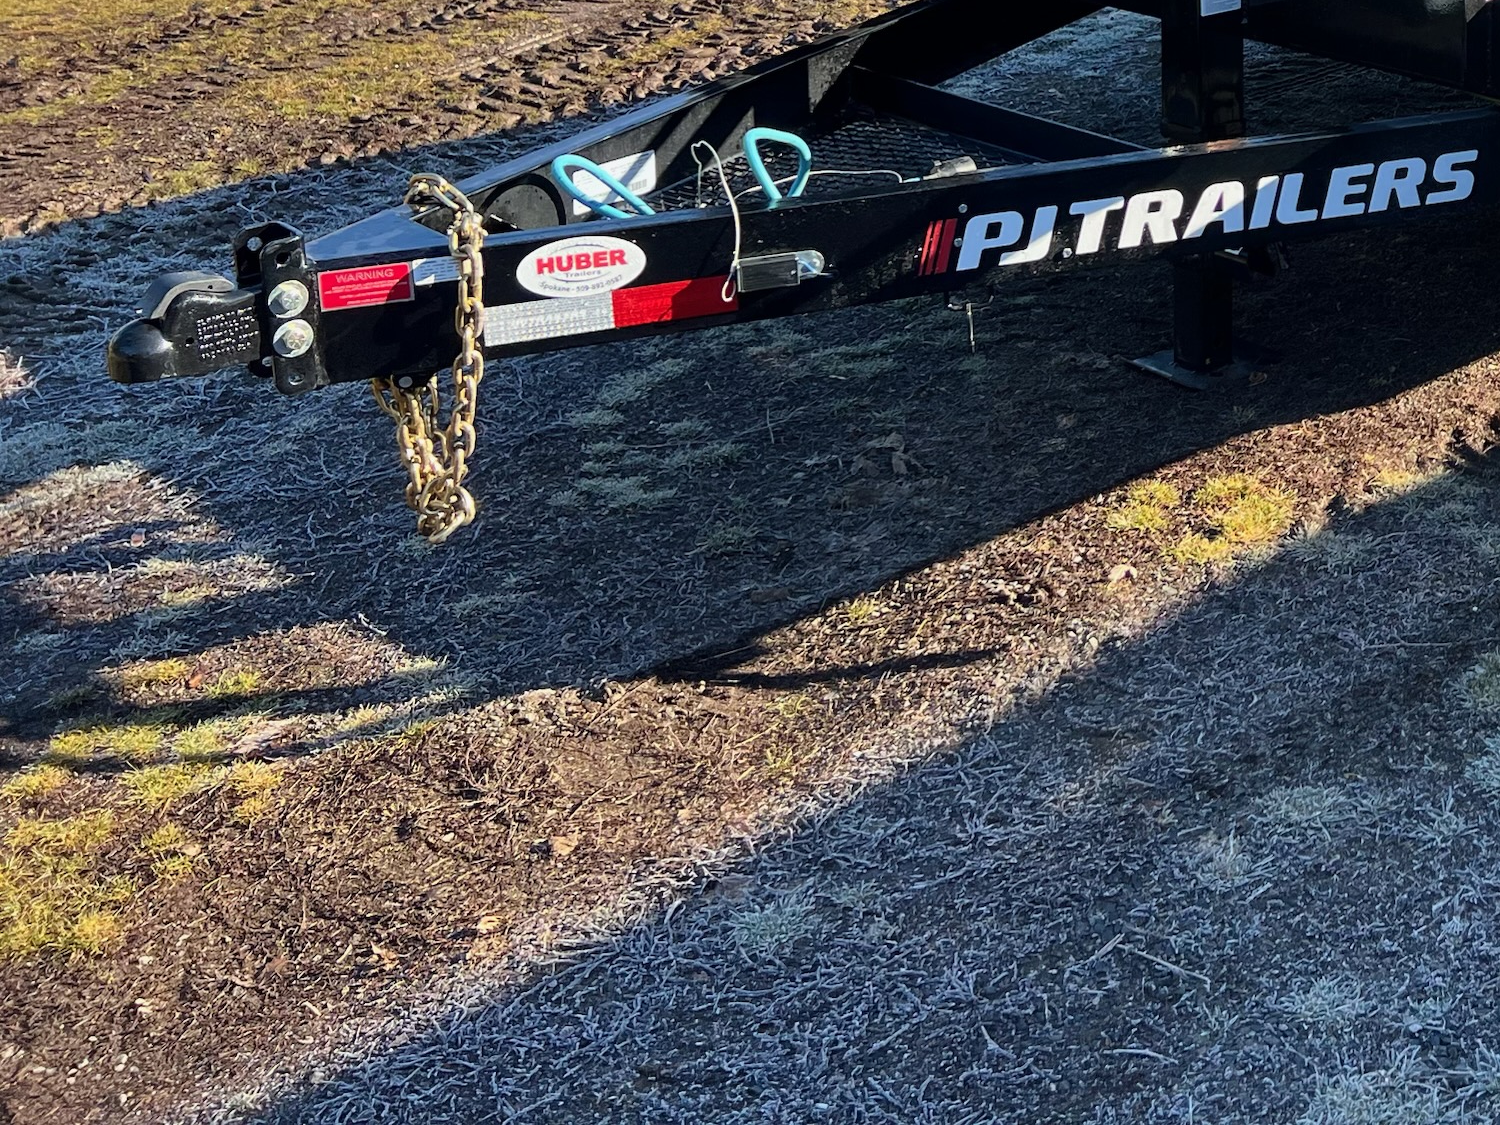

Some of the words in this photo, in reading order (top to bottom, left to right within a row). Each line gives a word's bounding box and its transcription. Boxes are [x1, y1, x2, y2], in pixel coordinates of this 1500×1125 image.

[955, 205, 1058, 271] PJ
[1069, 149, 1479, 256] TRAILERS
[535, 248, 628, 275] HUBER
[335, 268, 394, 284] WARNING
[564, 269, 602, 279] Trailers
[539, 280, 571, 293] Spokane
